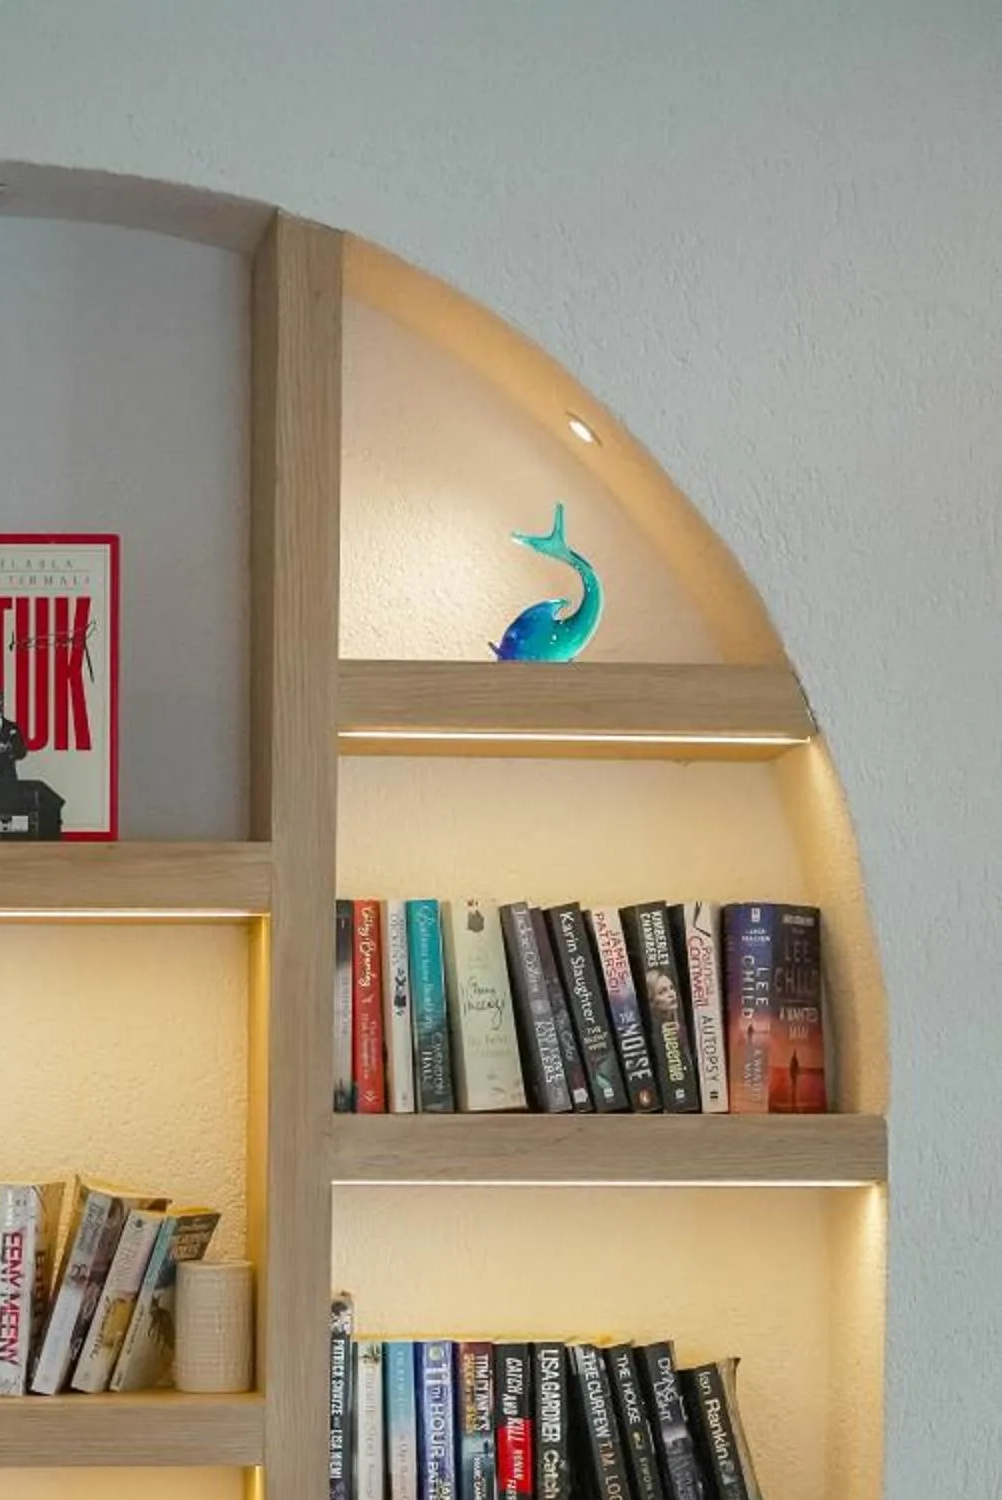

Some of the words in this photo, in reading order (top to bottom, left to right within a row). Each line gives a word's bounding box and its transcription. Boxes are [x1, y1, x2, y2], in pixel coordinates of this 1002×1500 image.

[514, 909, 531, 948] Jackie
[524, 951, 544, 995] Collins
[560, 911, 583, 953] Karin
[609, 930, 627, 978] JAMES
[641, 913, 658, 968] CHAMBERS
[654, 911, 670, 966] KIMBERLEY
[784, 937, 811, 963] LEE
[569, 957, 597, 1024] Slaughter
[689, 936, 709, 1007] Cornwell
[741, 954, 755, 1019] CHILD
[755, 967, 770, 1007] LEE
[774, 965, 819, 996] CHILD
[422, 1051, 434, 1084] HALL
[533, 1021, 555, 1084] KILLERS
[617, 1022, 642, 1081] NOISE
[661, 1021, 687, 1082] Queenie
[701, 1015, 719, 1083] AUTOPSY
[1, 1230, 24, 1287] EENY
[332, 1339, 345, 1378] PATRICK
[475, 1353, 491, 1378] TOM
[505, 1357, 524, 1394] CATCH
[540, 1349, 560, 1381] LISA
[581, 1352, 597, 1381] THE
[616, 1353, 632, 1380] THE
[657, 1356, 680, 1405] DYING
[331, 1379, 344, 1416] SWAYZE
[473, 1379, 491, 1431] CLANCY'S
[502, 1393, 518, 1416] AND
[621, 1382, 642, 1426] HOUSE
[653, 1380, 673, 1424] LIGHT
[697, 1370, 713, 1397] Ian
[429, 1402, 445, 1459] HOUR
[506, 1417, 526, 1443] KILL
[541, 1382, 561, 1443] GARDNER
[585, 1381, 612, 1439] CURFEW
[703, 1398, 731, 1461] Rankin
[331, 1429, 344, 1449] LISA
[599, 1440, 615, 1472] T.M.
[330, 1451, 343, 1480] NIEMI
[543, 1449, 561, 1500] Catch
[638, 1456, 653, 1492] SIMON
